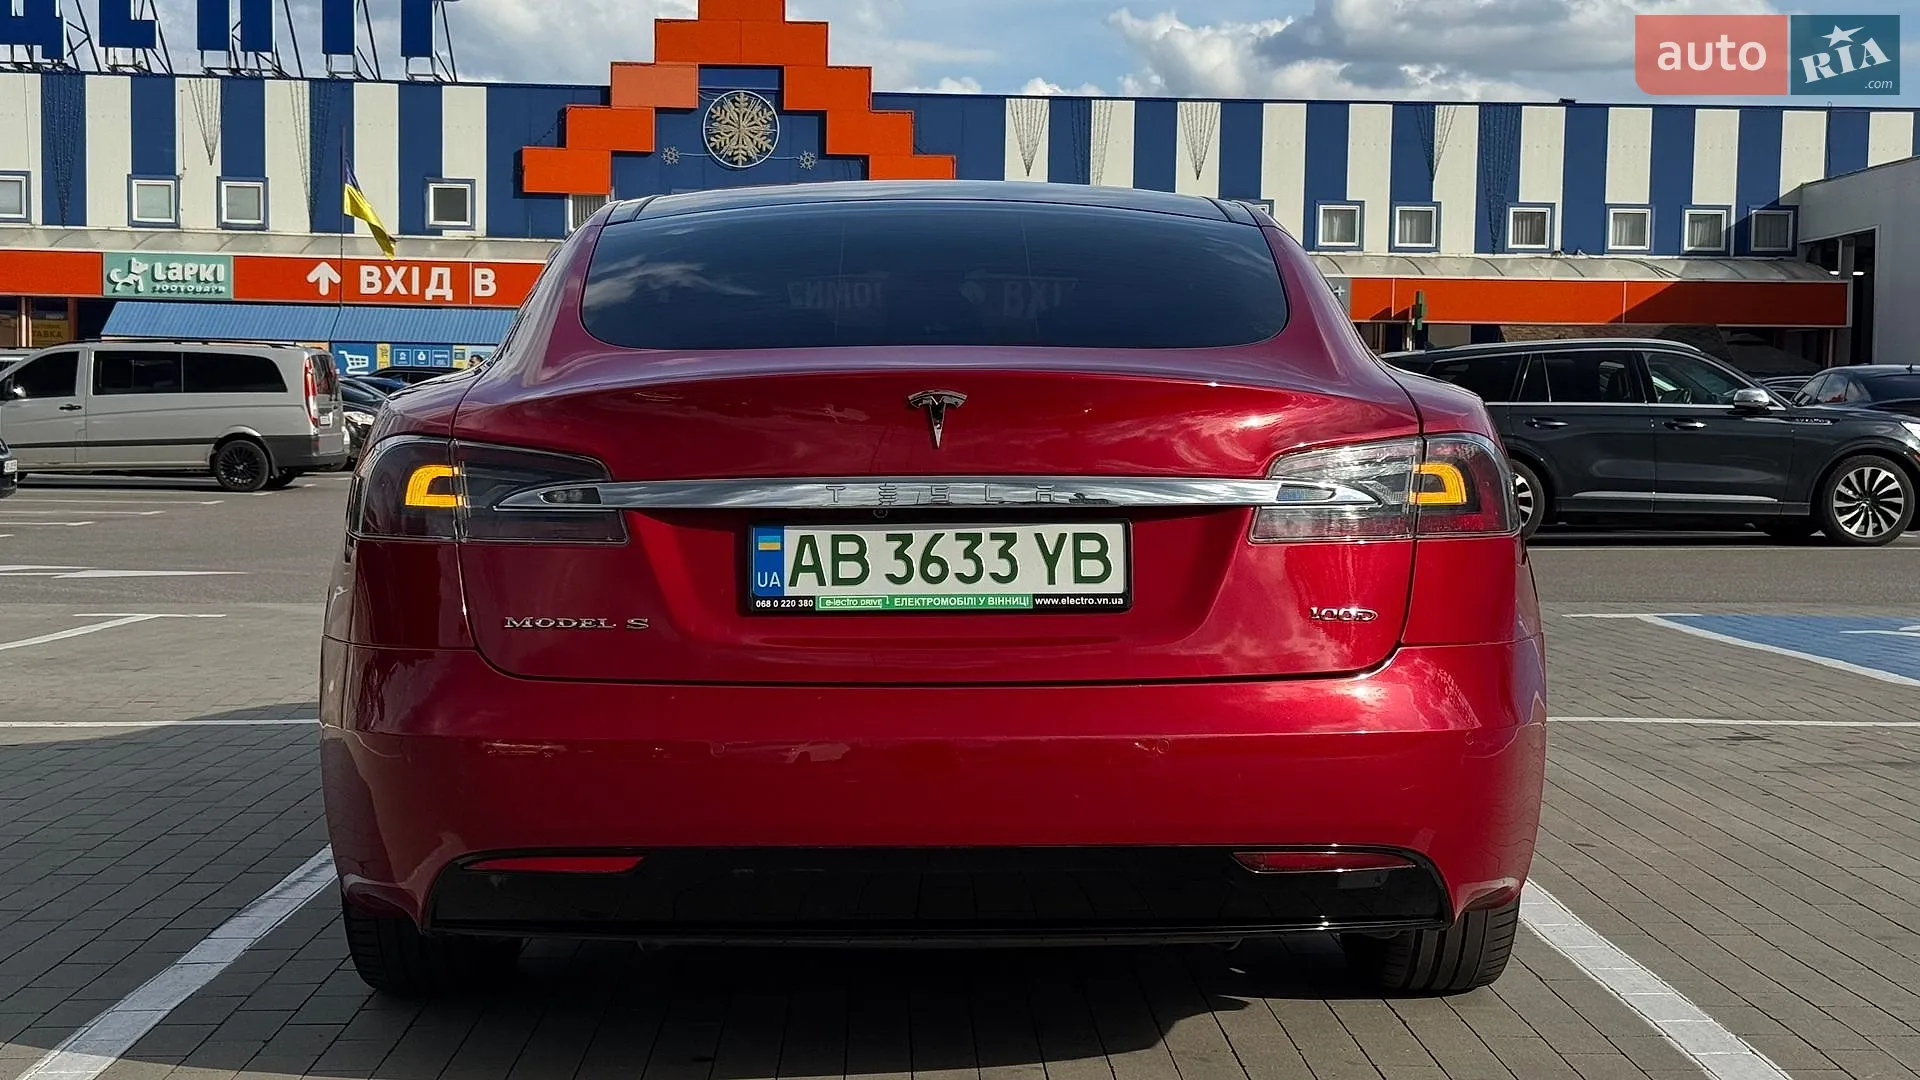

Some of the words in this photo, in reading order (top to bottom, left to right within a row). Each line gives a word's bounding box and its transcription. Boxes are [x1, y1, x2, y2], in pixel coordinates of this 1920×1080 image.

[359, 265, 454, 301] ВХІД
[826, 485, 1056, 503] TESLA
[788, 533, 871, 587] AB
[885, 532, 1020, 585] 3633
[757, 573, 782, 588] UA
[756, 599, 772, 608] 068
[773, 599, 780, 608] 0
[781, 599, 797, 608] 220
[798, 599, 814, 607] 380
[894, 597, 976, 607] ЕЛЕКТРОМОБІЛІ
[978, 597, 986, 606] У
[988, 596, 1030, 607] ВІННИЦІ
[1035, 596, 1124, 605] www.electro.vn.ua
[504, 616, 617, 629] MODEL
[626, 618, 650, 630] S
